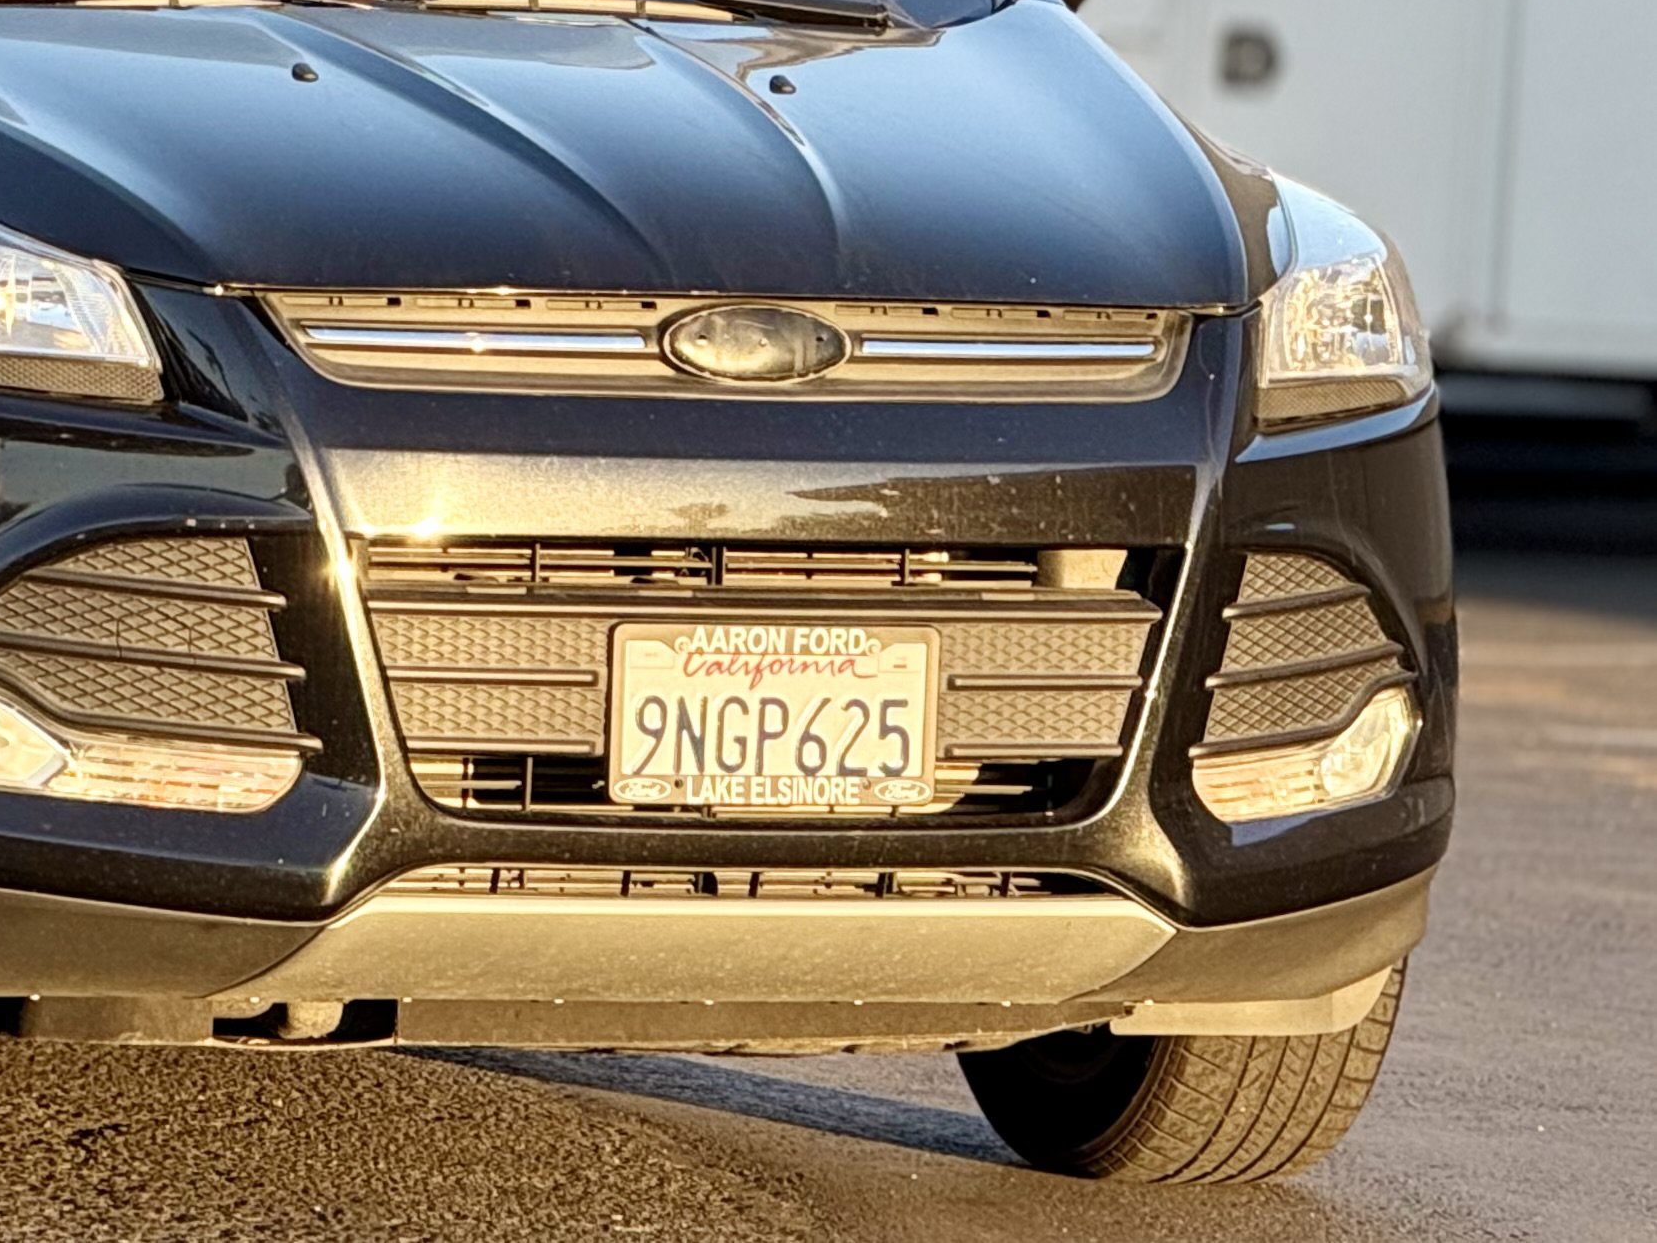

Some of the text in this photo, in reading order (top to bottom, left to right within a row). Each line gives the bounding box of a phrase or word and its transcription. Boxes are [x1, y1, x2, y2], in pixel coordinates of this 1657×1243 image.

[692, 626, 867, 655] AARON FORD
[682, 651, 878, 691] California
[634, 695, 911, 776] 9NGP625
[686, 775, 861, 806] LAKE ELSINORE
